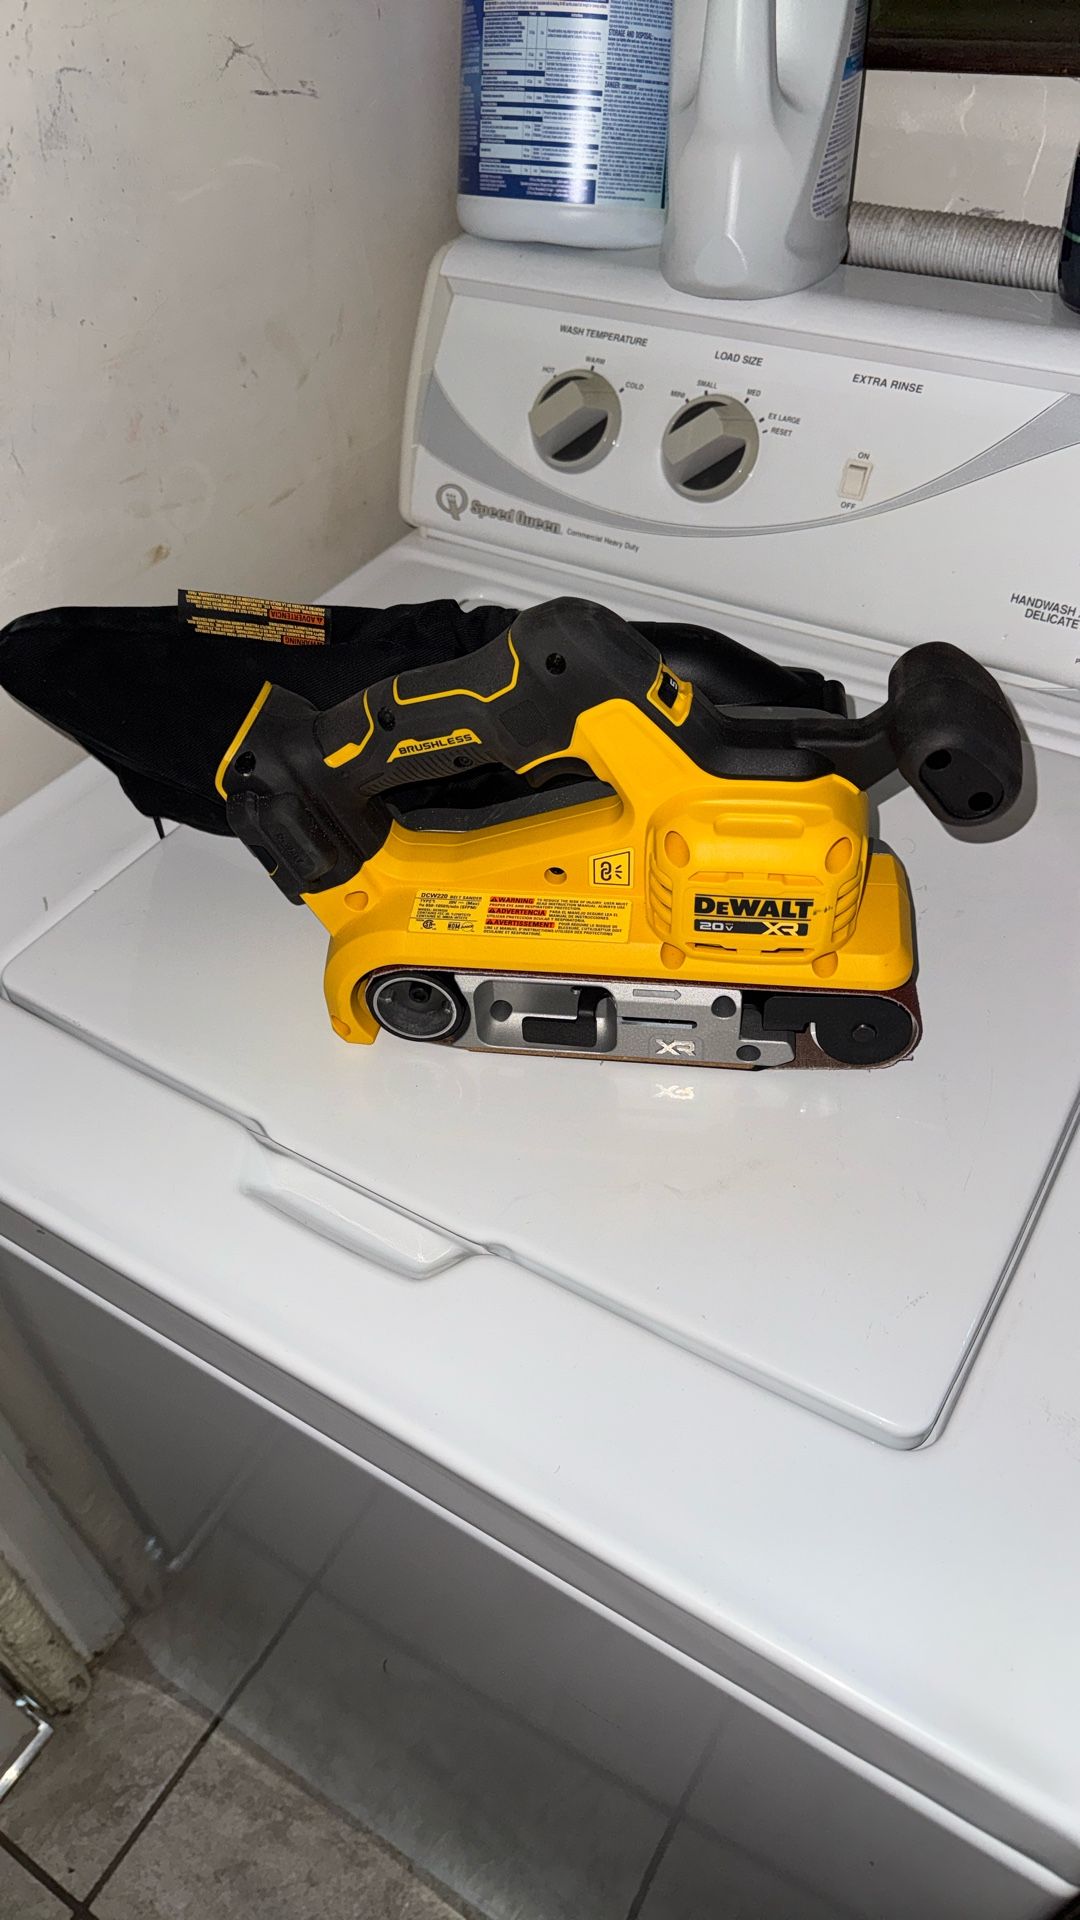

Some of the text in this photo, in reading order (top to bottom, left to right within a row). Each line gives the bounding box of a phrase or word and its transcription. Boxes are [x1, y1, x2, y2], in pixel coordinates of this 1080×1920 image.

[608, 28, 625, 37] STORAGE
[559, 324, 648, 347] WASH TEMPERATURE
[585, 356, 606, 365] WARM
[714, 351, 764, 366] LOAD SIZE
[625, 381, 645, 391] COLD
[696, 380, 718, 389] SMALL
[852, 374, 924, 394] EXTRA RINSE
[670, 390, 686, 399] MINI
[746, 389, 761, 397] MED
[778, 415, 801, 425] LARGE
[770, 427, 793, 437] RESET
[857, 452, 870, 460] ON
[840, 501, 856, 510] OFF
[470, 499, 514, 523] Speed
[566, 528, 639, 552] Commercial Heavy Duty
[1010, 593, 1077, 616] HANDWASH
[270, 611, 315, 622] ADVERTENCIA
[398, 734, 472, 754] BRUSHLESS
[496, 908, 546, 916] ADVERTENCIA
[493, 920, 554, 928] AVERTISSEMENT
[762, 921, 798, 936] XR
[656, 1039, 696, 1056] XR
